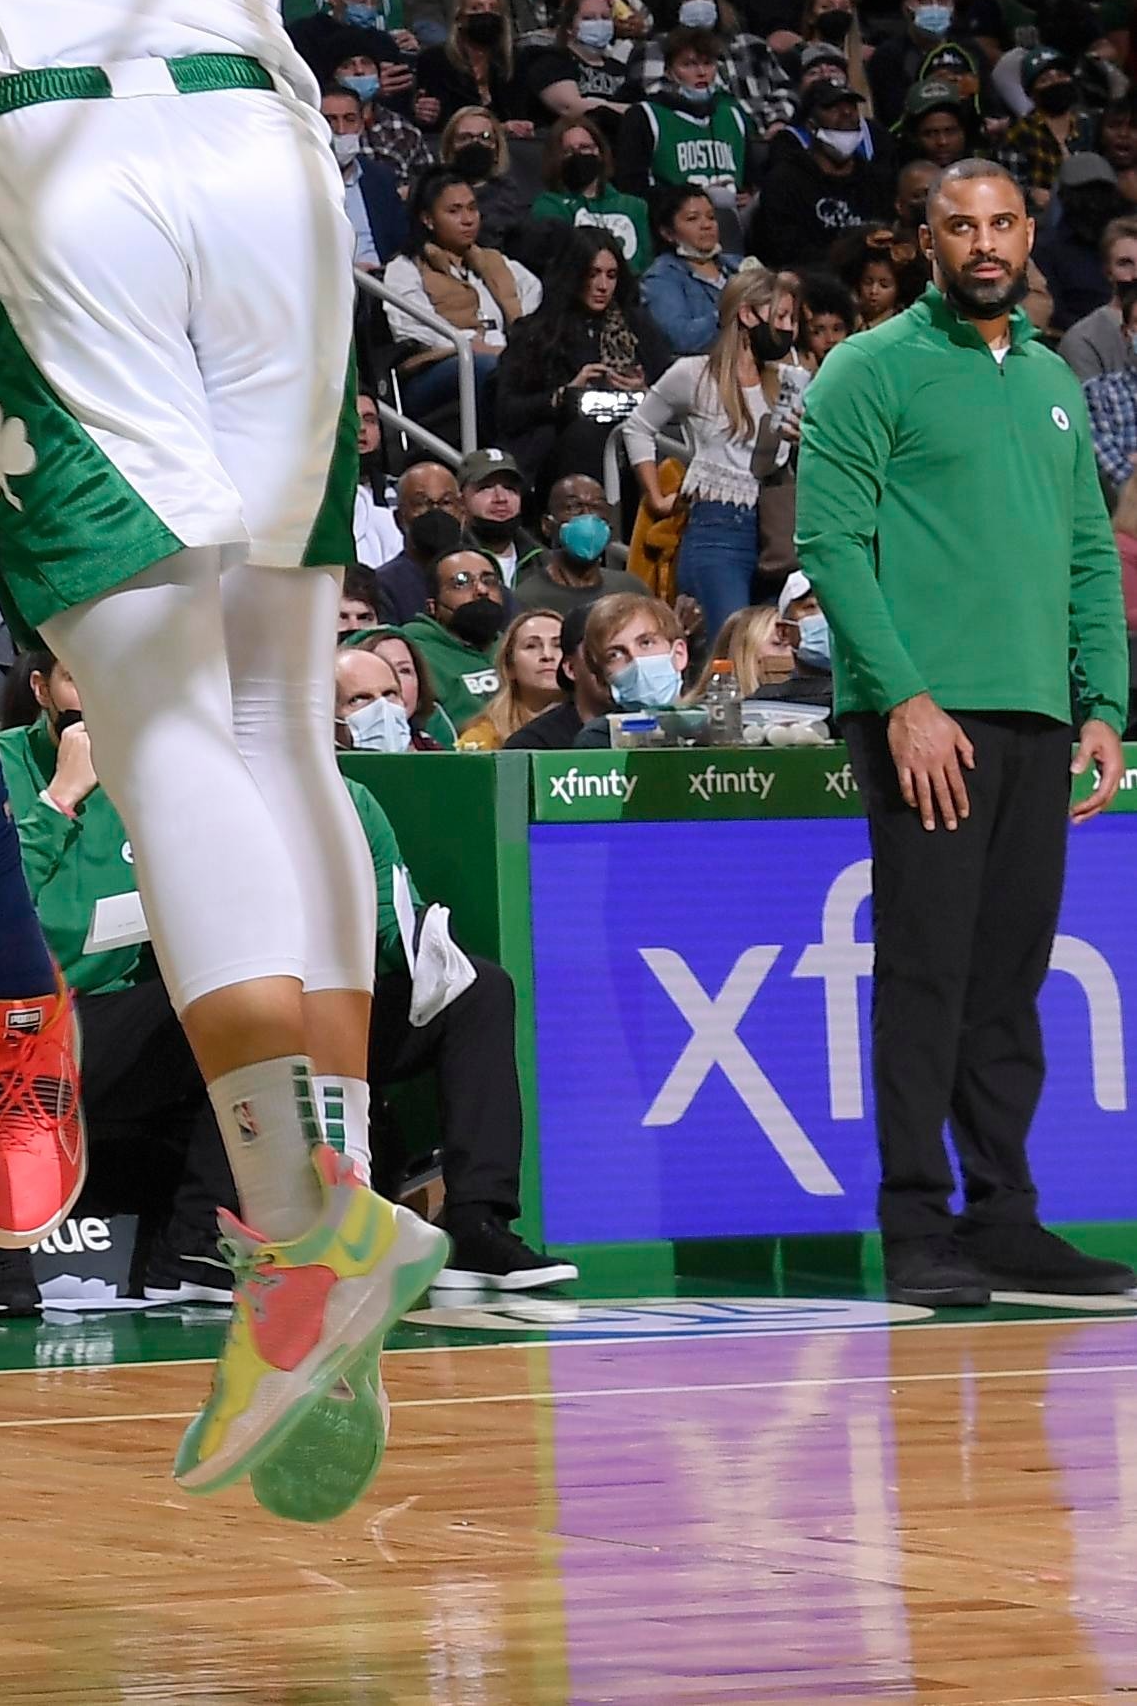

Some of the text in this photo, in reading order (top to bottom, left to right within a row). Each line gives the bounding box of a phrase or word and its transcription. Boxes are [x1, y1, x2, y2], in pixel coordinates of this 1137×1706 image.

[676, 139, 736, 172] BOSTON
[549, 767, 639, 805] xfinity
[688, 765, 775, 801] xfinity
